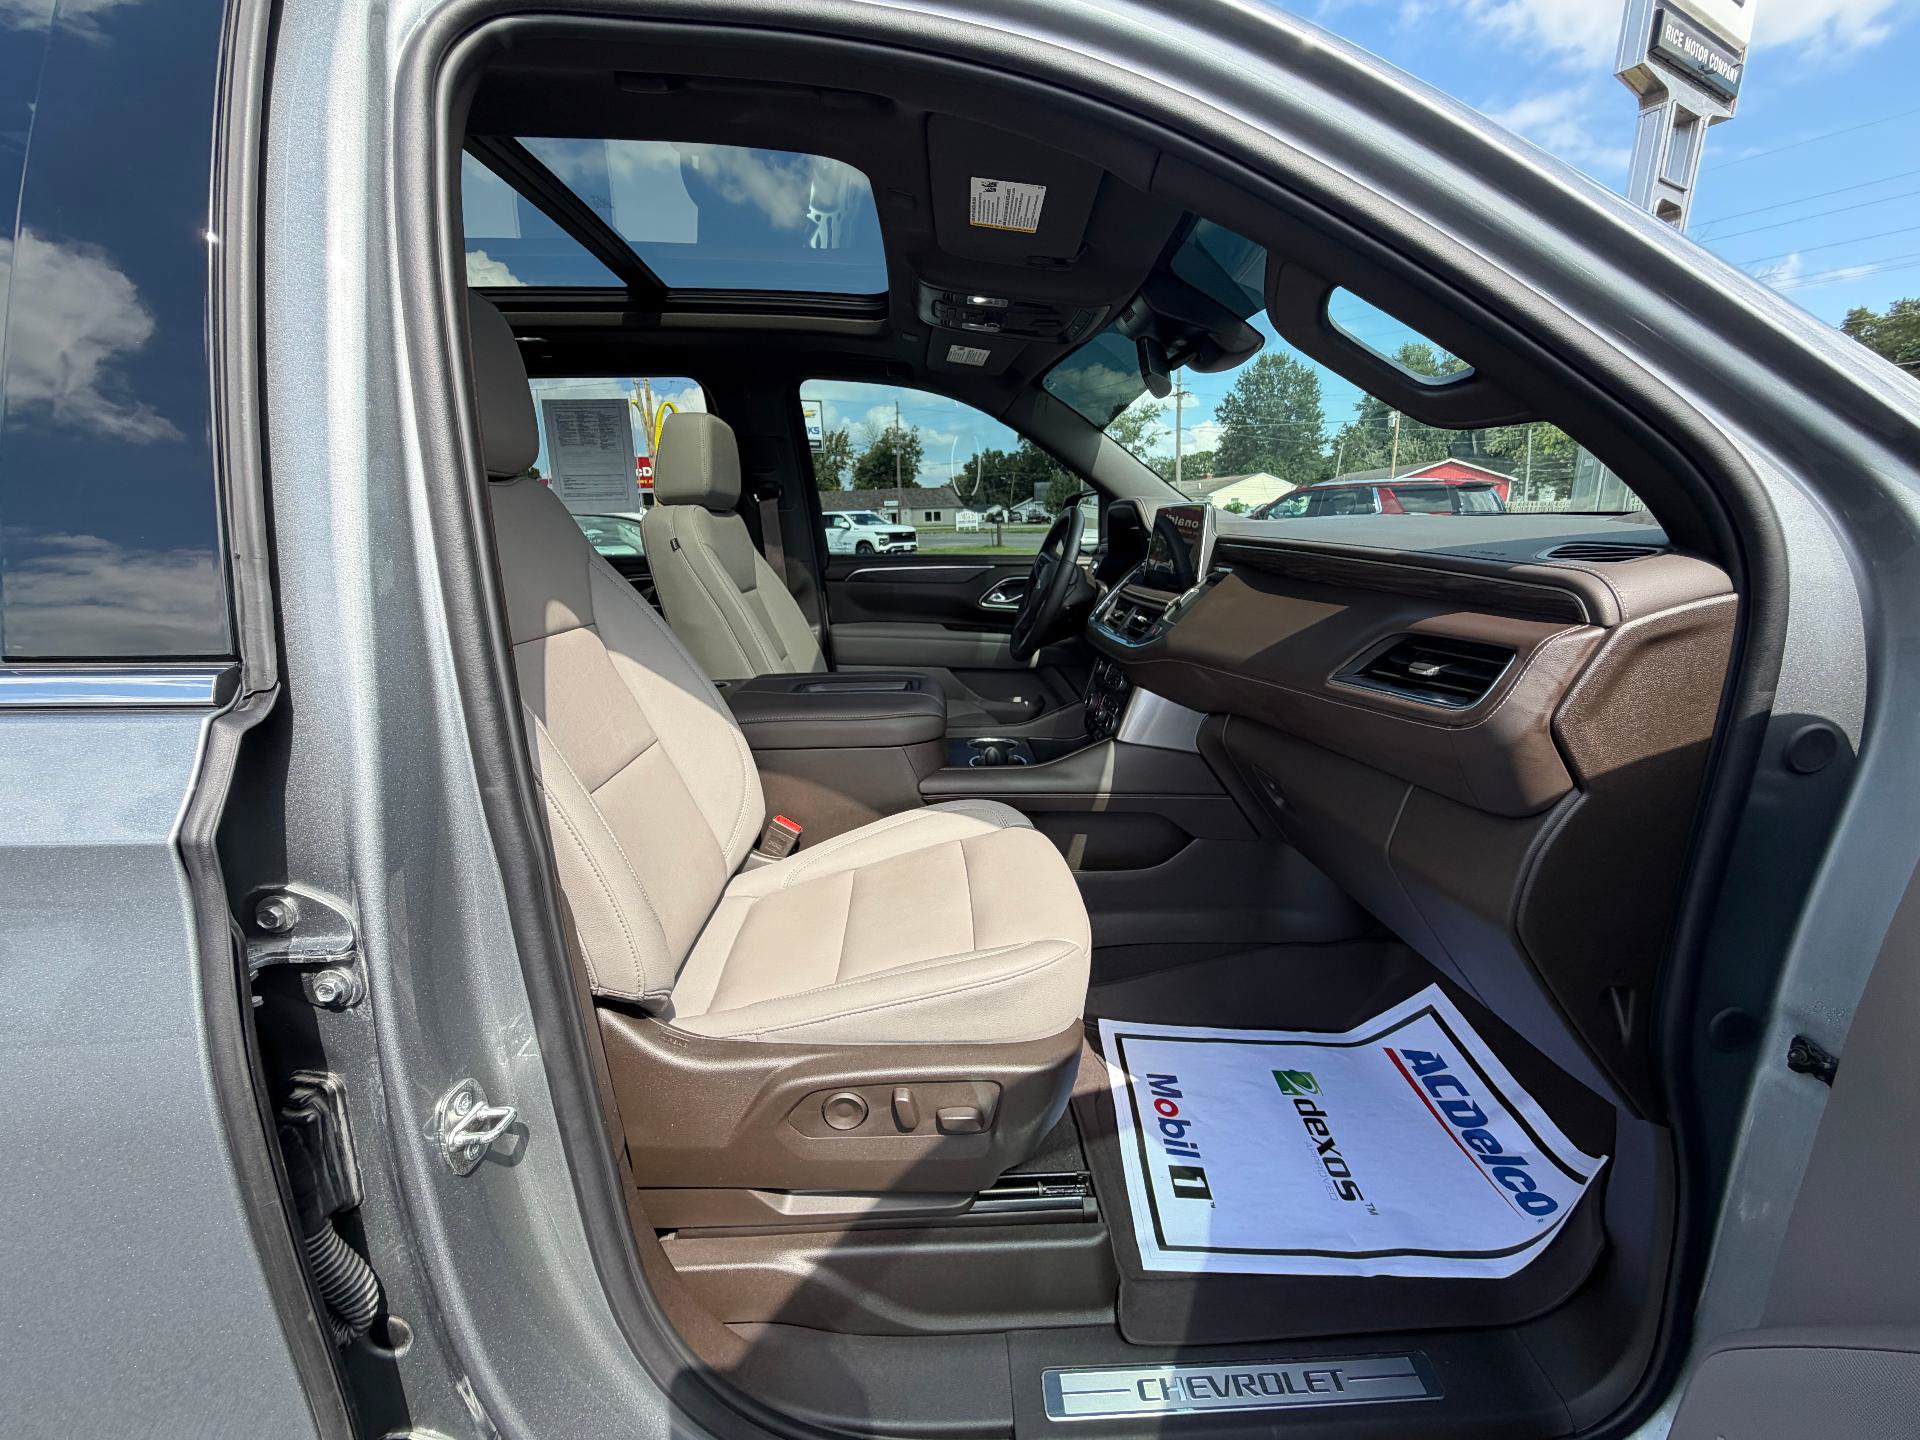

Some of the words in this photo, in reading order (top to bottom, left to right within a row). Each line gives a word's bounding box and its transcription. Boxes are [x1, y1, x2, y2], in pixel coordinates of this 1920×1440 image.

[1665, 24, 1684, 48] RICE
[1684, 36, 1709, 64] MOTOR
[1709, 53, 1739, 84] COMPANY
[1146, 1073, 1201, 1158] Mobil
[1293, 1098, 1365, 1201] dexos
[1400, 1049, 1558, 1216] ACDelco
[1136, 1368, 1345, 1402] CHEVROLET
